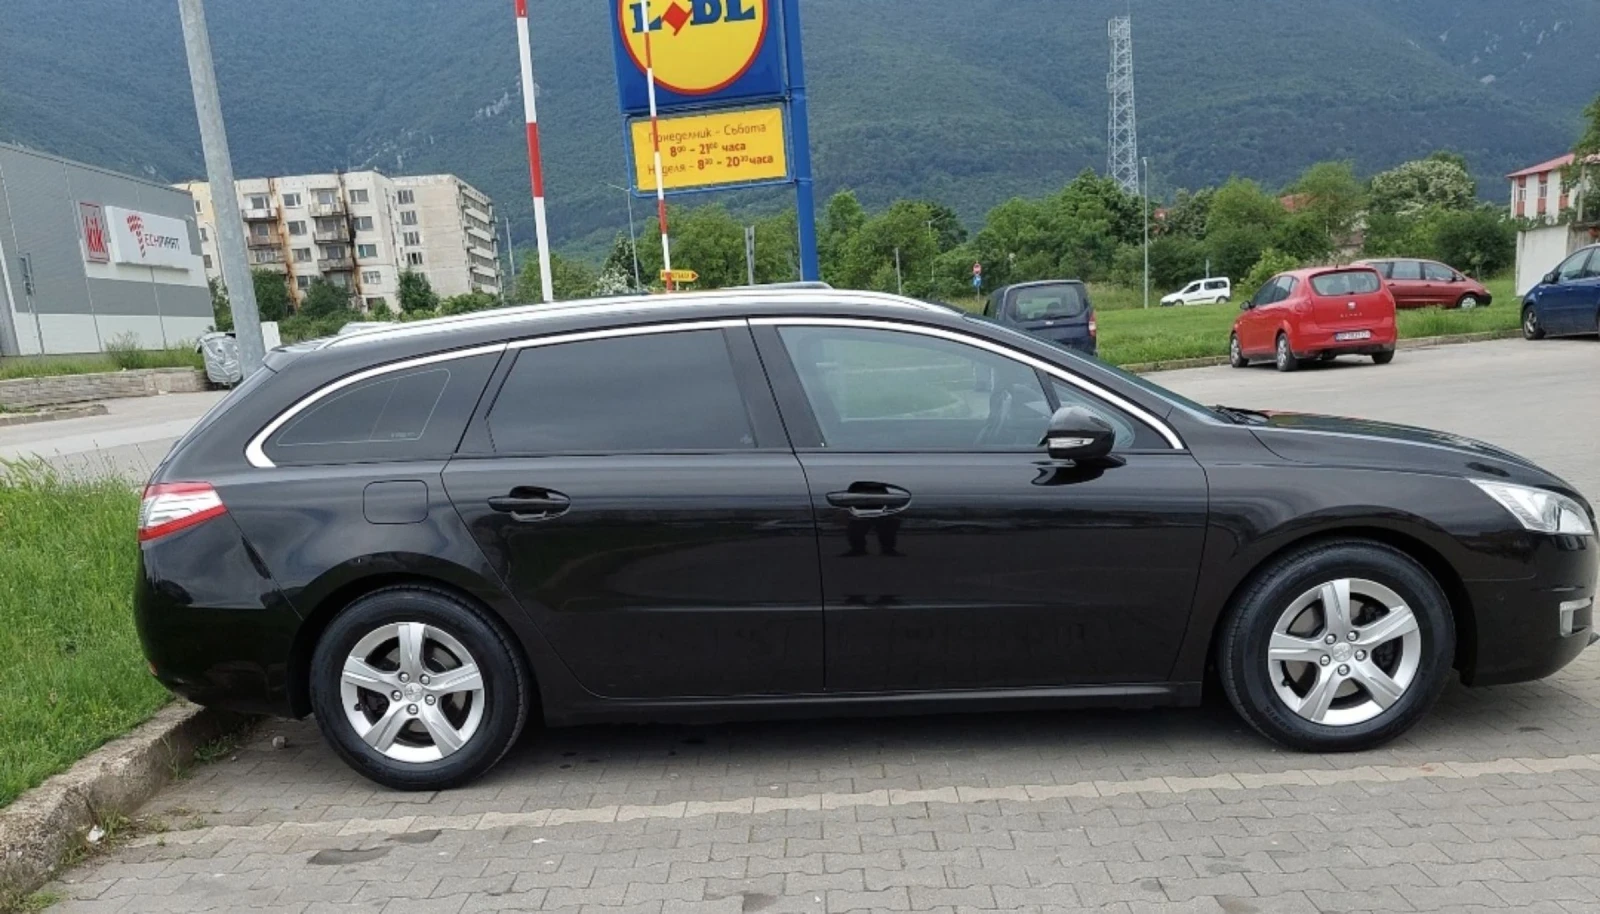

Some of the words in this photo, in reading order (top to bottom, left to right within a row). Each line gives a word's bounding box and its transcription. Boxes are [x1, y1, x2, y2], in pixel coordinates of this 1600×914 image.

[723, 123, 767, 136] Събота
[721, 143, 747, 152] часа
[648, 164, 687, 177] Нделя
[749, 155, 774, 165] часа
